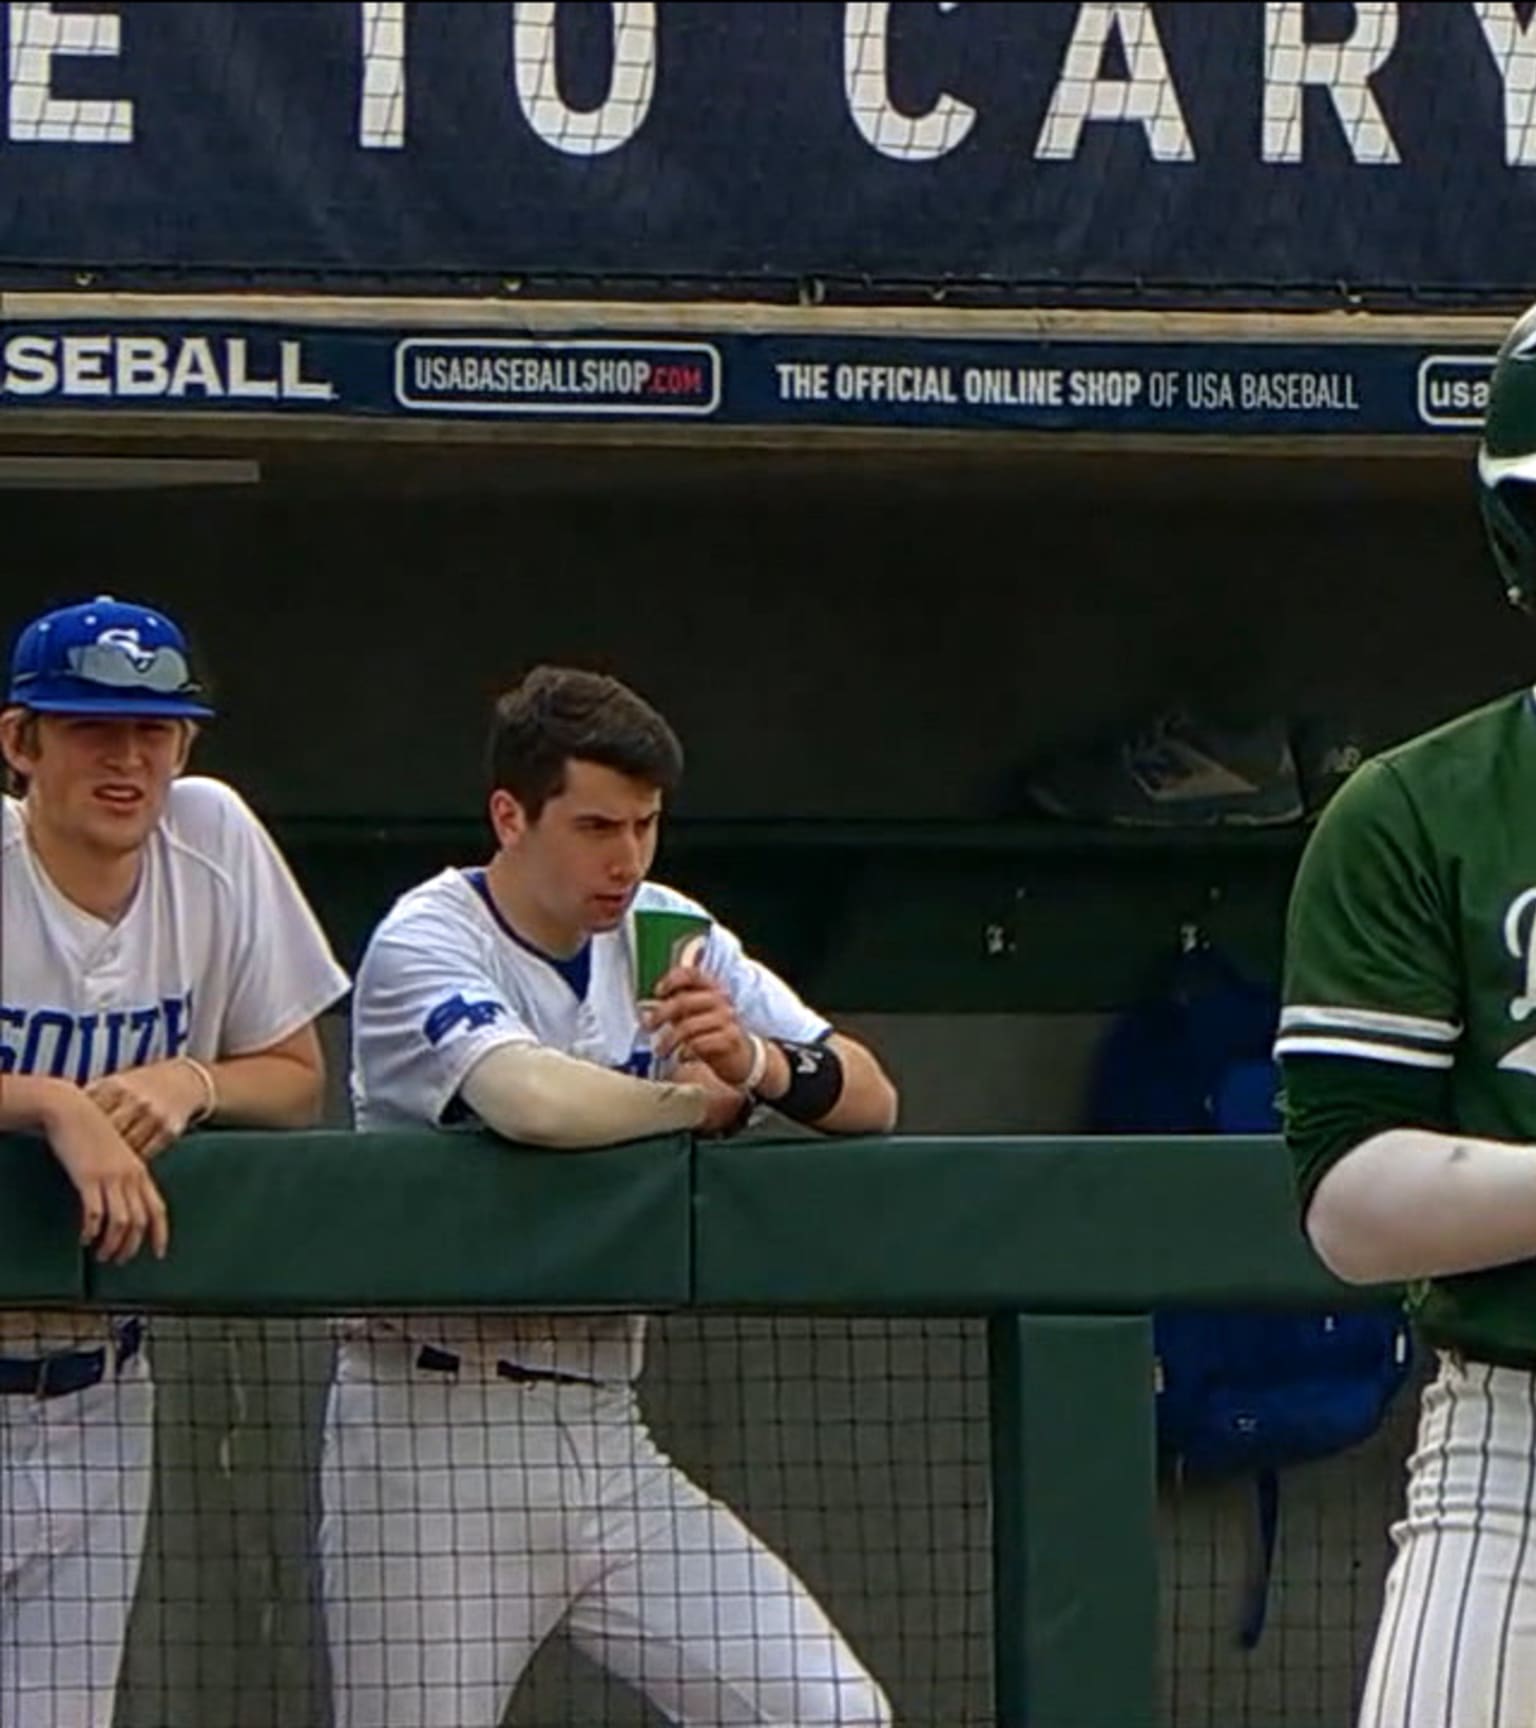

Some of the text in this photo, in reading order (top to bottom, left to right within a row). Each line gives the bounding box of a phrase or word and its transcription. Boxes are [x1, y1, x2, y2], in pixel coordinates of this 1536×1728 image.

[2, 336, 335, 400] SEBALL
[415, 356, 702, 395] USABASEBALLSHOP.COM
[775, 363, 1359, 411] THE OFFICIAL ONLINE SHOP OF USA BASEBALL
